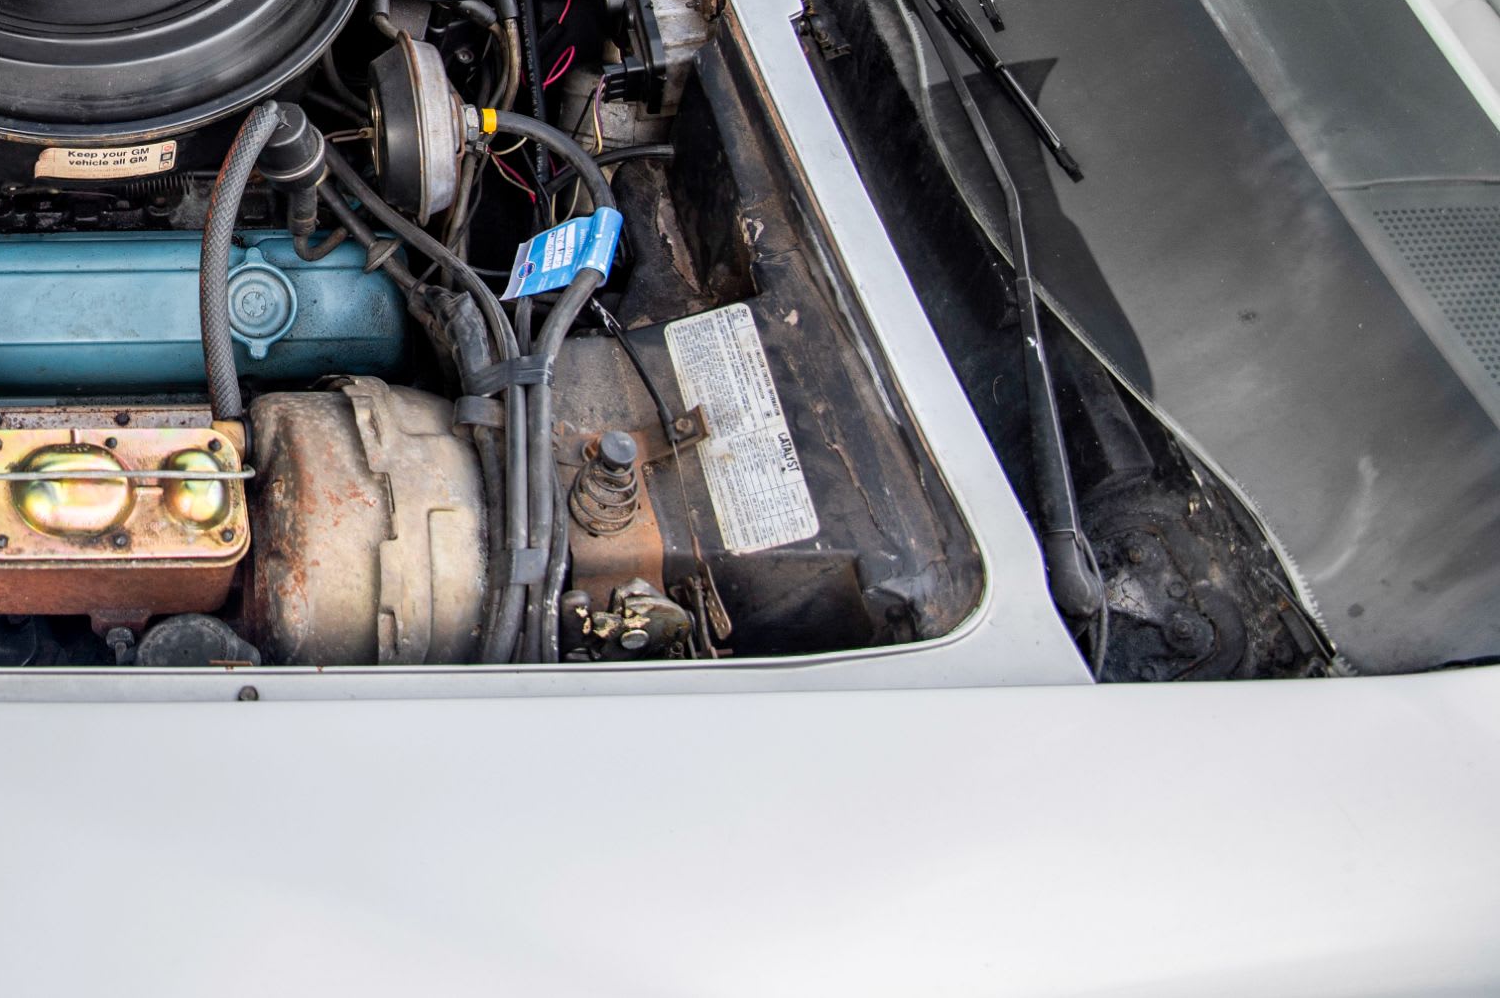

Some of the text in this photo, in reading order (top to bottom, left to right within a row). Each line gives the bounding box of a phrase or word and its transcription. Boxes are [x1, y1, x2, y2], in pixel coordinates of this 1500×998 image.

[67, 147, 150, 159] Keep your GM
[69, 156, 148, 166] vehicle all GM
[777, 431, 800, 472] CATALYST
